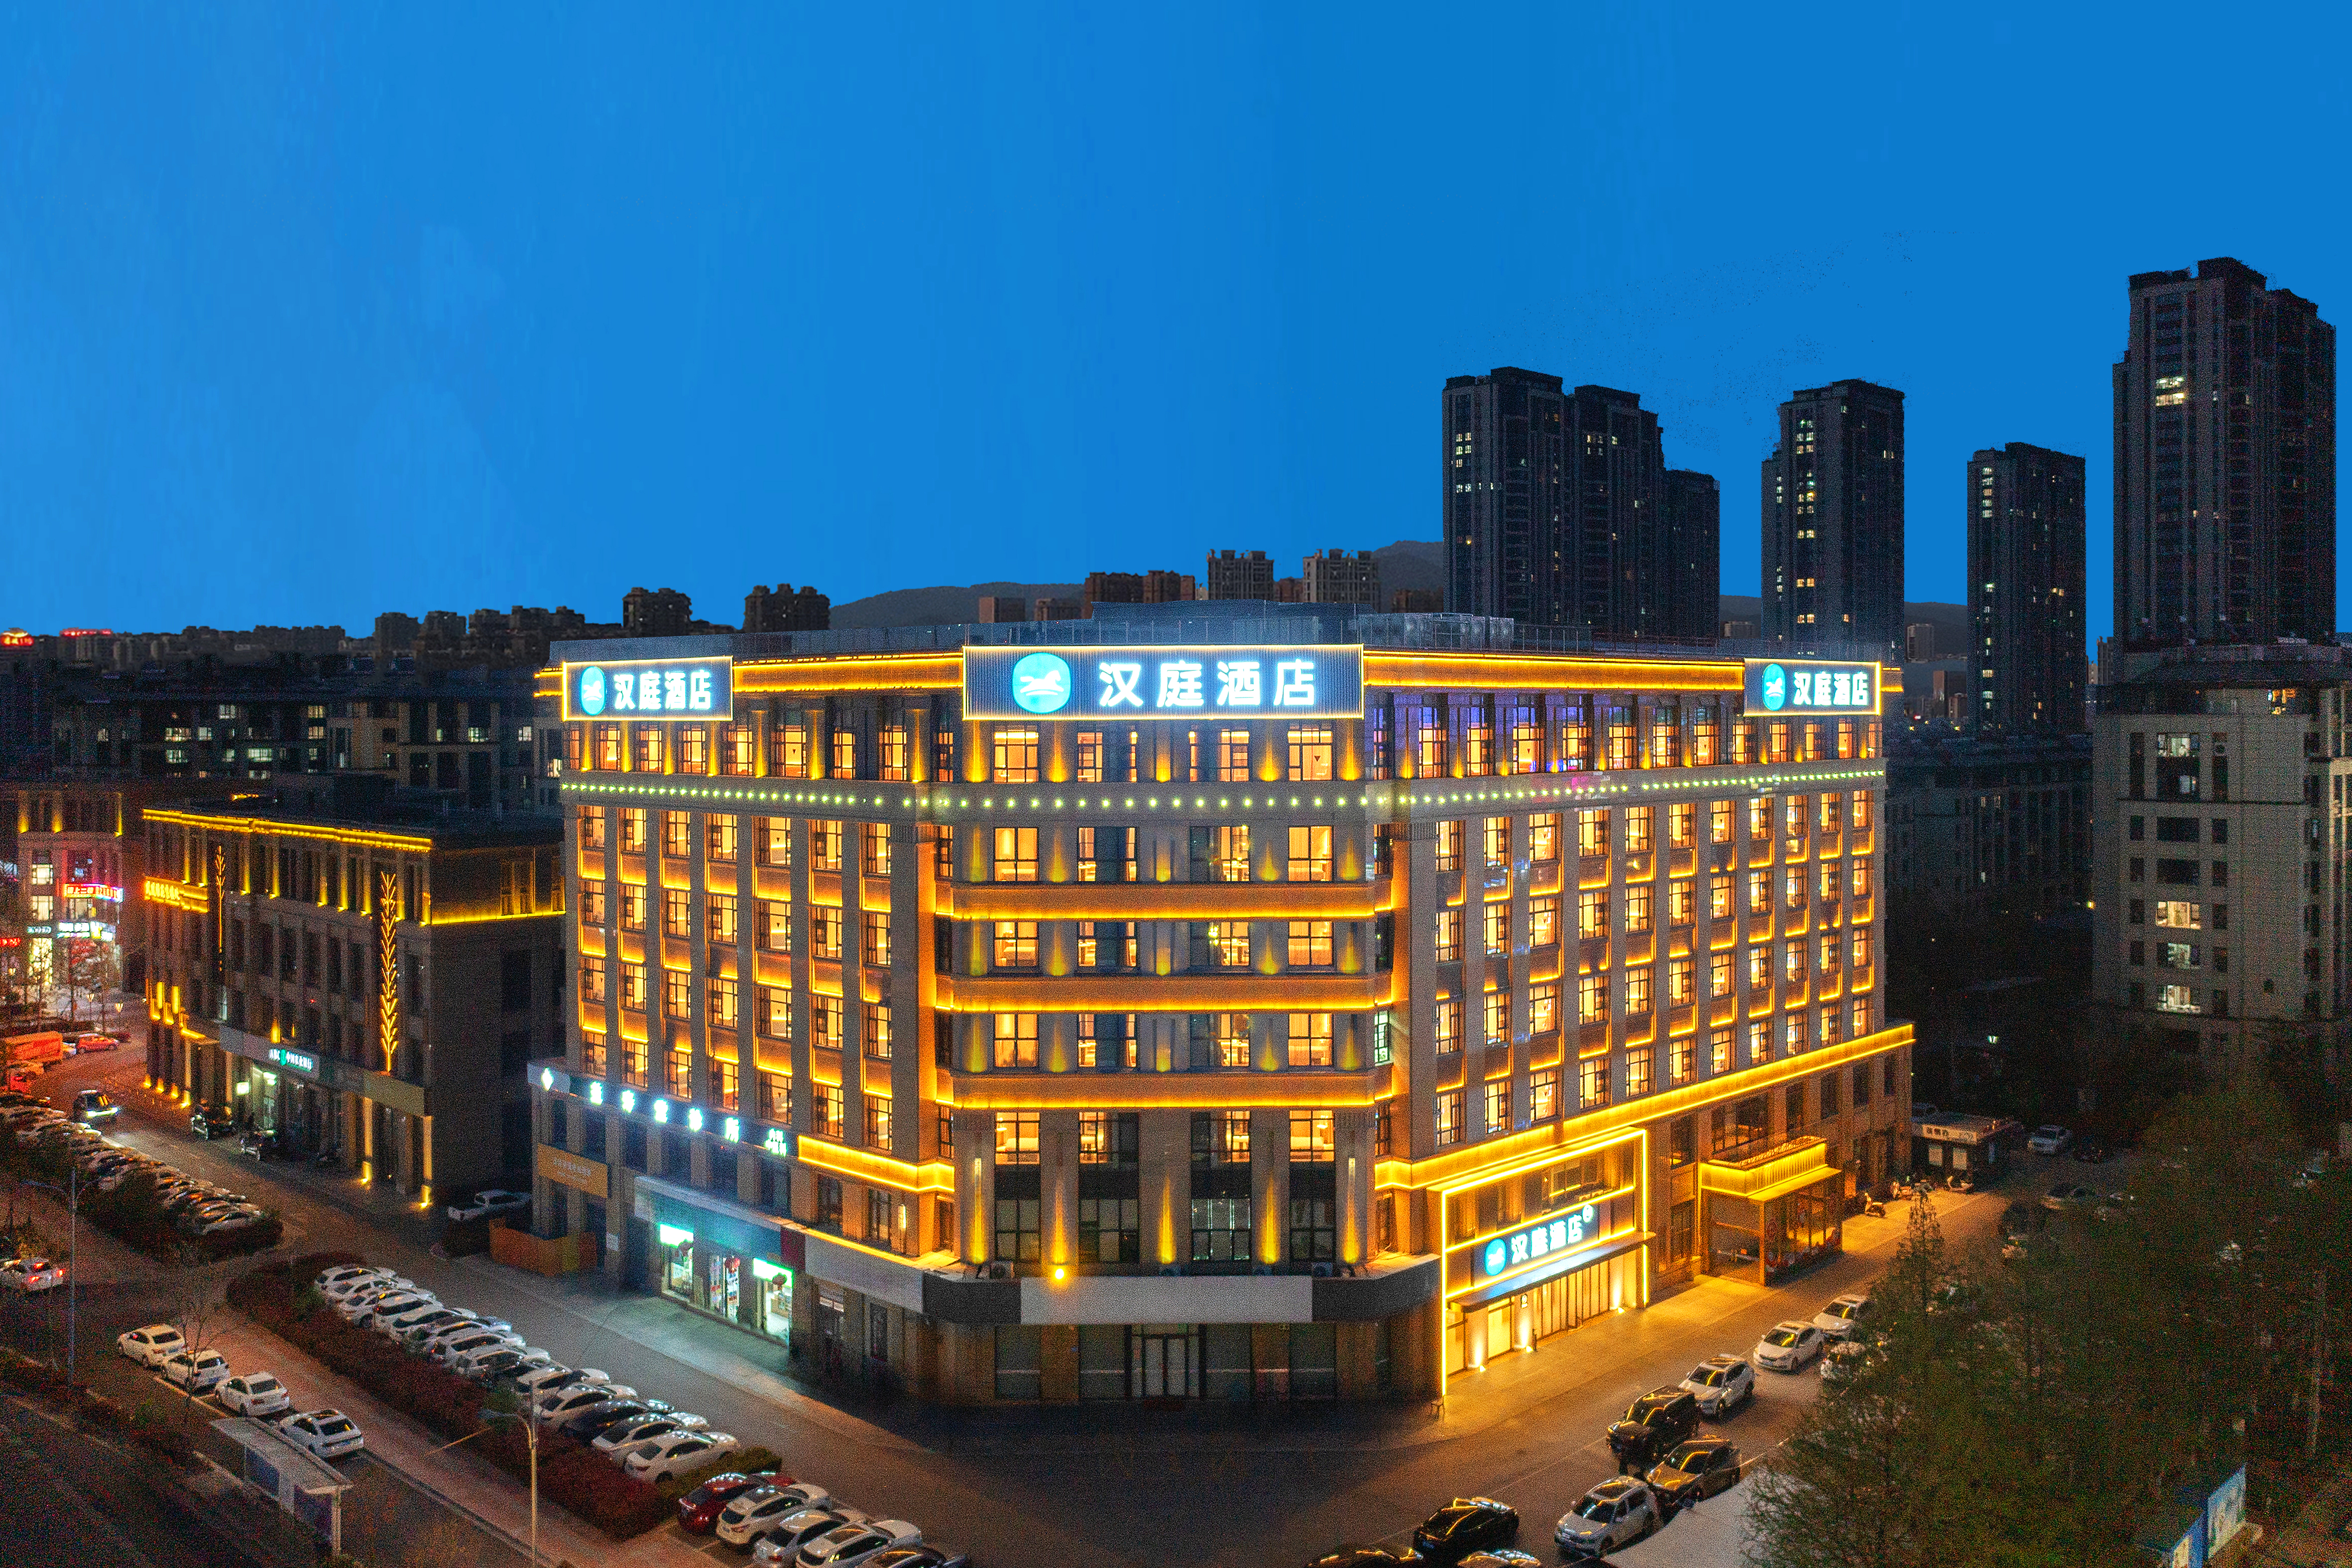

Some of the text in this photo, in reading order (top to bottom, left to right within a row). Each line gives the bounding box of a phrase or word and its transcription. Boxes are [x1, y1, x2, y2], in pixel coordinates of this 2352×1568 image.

[613, 669, 711, 710] 汉庭酒店
[1099, 658, 1315, 707] 汉庭酒店
[1793, 671, 1868, 706] 汉庭酒店
[1511, 1214, 1583, 1264] 汉庭酒店
